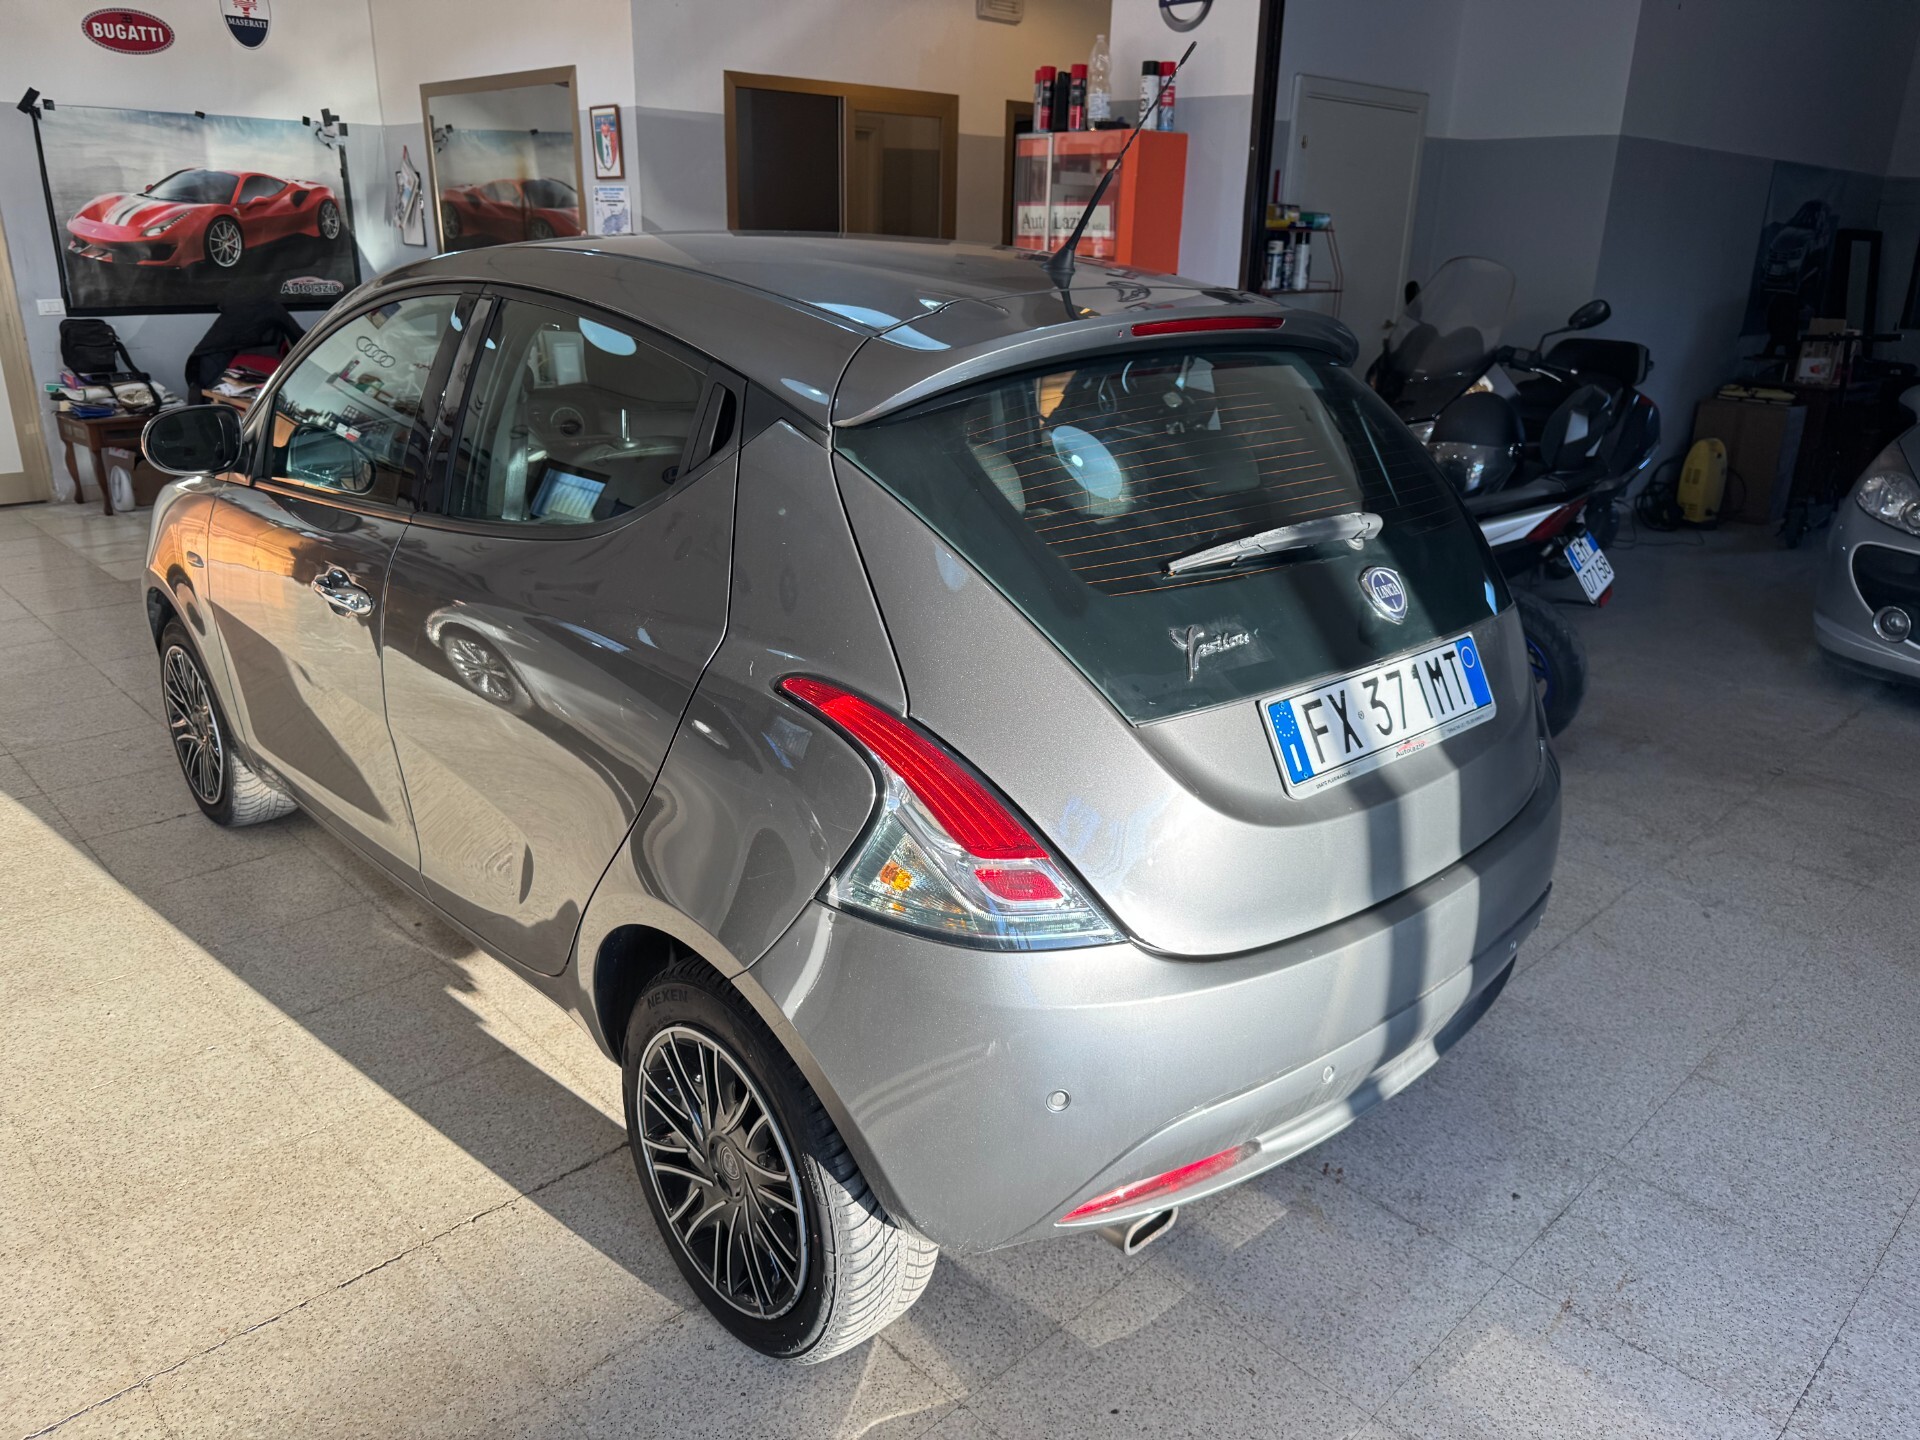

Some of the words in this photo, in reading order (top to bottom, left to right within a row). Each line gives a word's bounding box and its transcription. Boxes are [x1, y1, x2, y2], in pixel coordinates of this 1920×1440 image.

[91, 22, 164, 43] BUGATTI
[227, 17, 267, 29] MASERATI
[1021, 212, 1046, 230] Aut
[1582, 555, 1612, 594] 07158
[1375, 582, 1401, 599] LANCIA
[647, 989, 688, 1010] NEXEN
